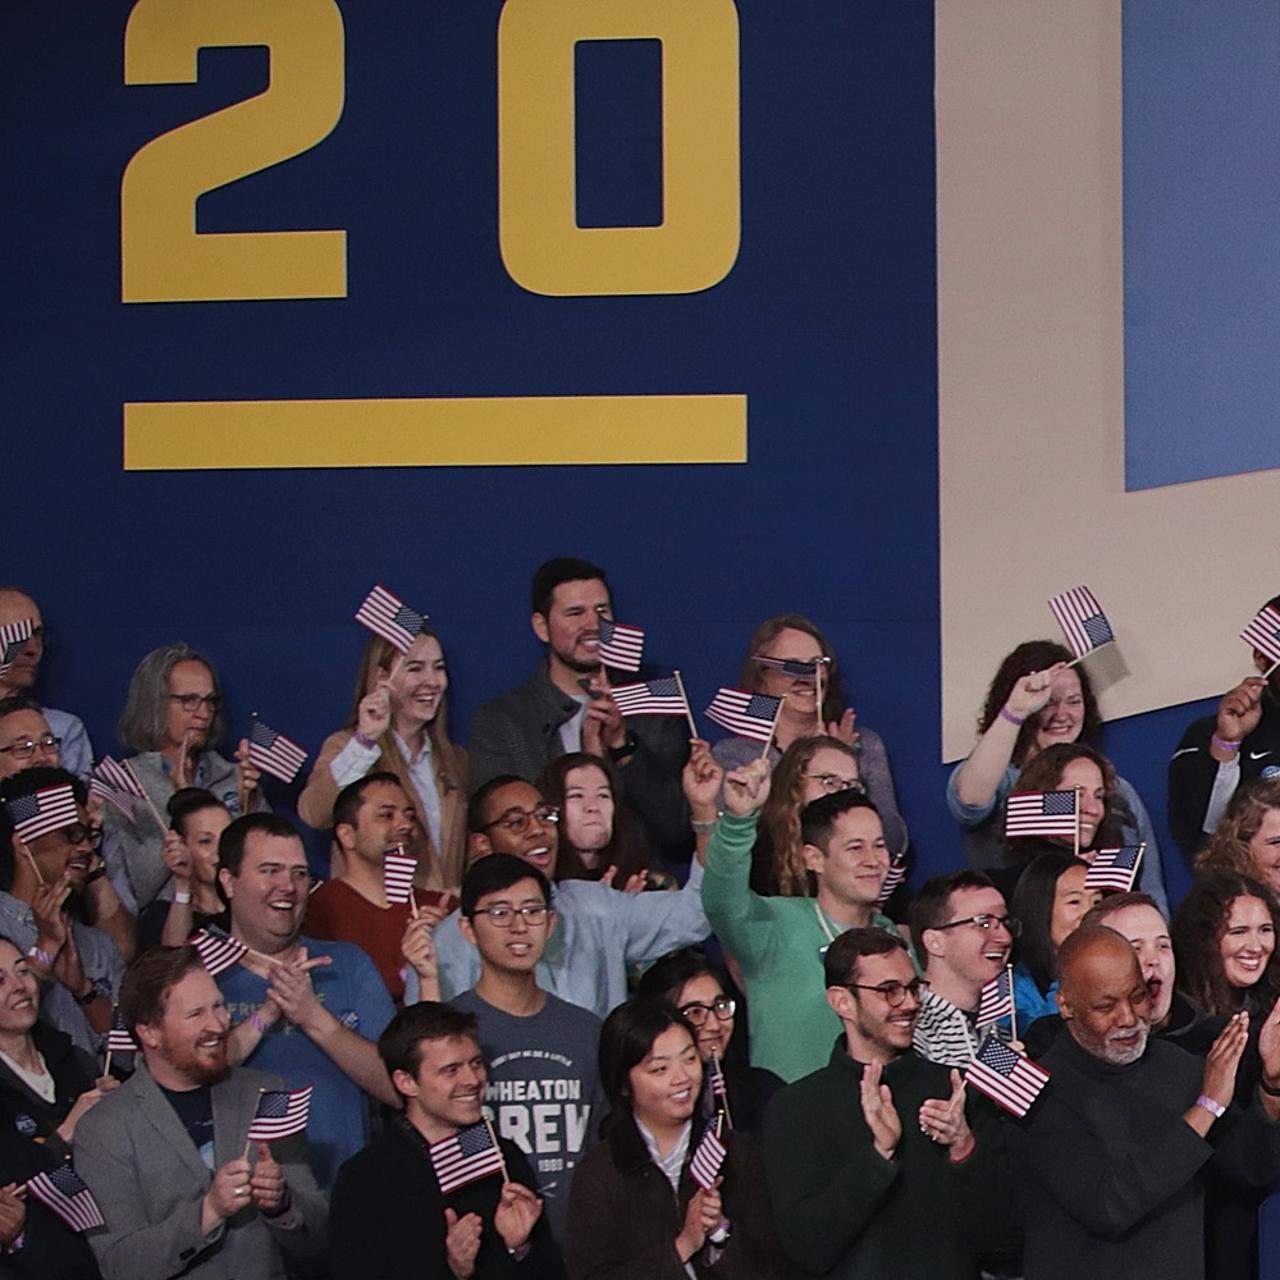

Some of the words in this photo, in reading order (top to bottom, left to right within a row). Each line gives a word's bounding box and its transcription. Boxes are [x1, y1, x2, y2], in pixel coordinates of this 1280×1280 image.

[122, 0, 740, 303] 20
[487, 1080, 581, 1101] WHEATON
[482, 1104, 591, 1154] REW
